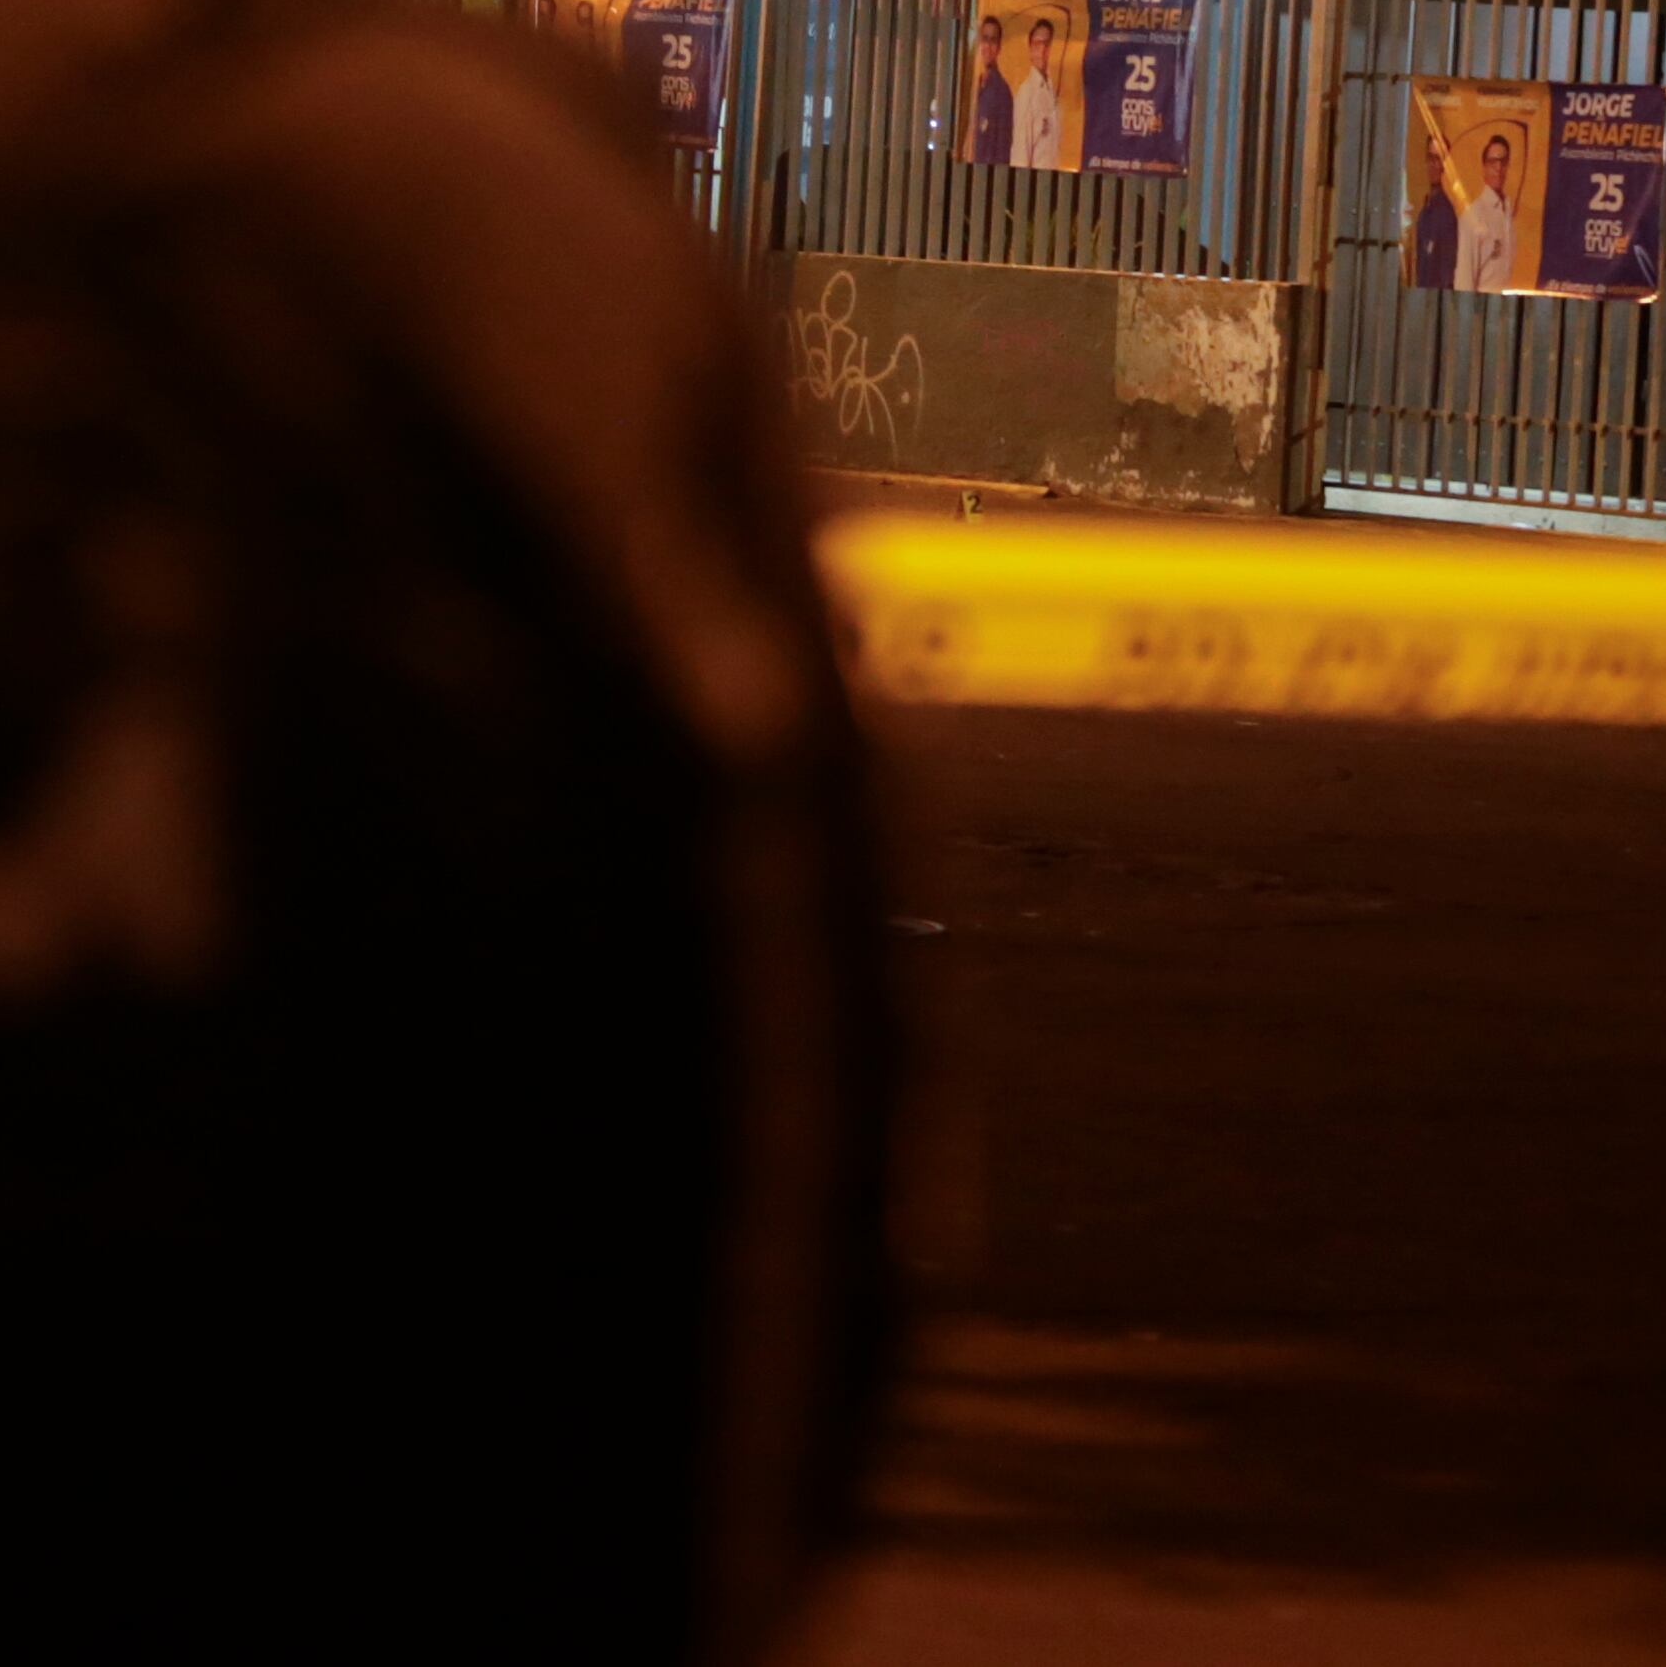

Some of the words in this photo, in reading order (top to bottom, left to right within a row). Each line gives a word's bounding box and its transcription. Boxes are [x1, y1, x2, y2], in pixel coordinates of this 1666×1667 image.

[662, 35, 692, 69] 25
[1124, 55, 1156, 91] 25
[1122, 98, 1154, 117] cons
[1562, 92, 1635, 118] JORGE
[1561, 115, 1664, 148] PEÑAFIEL
[1588, 173, 1624, 212] 25
[1585, 218, 1622, 238] cons
[967, 494, 984, 514] 2
